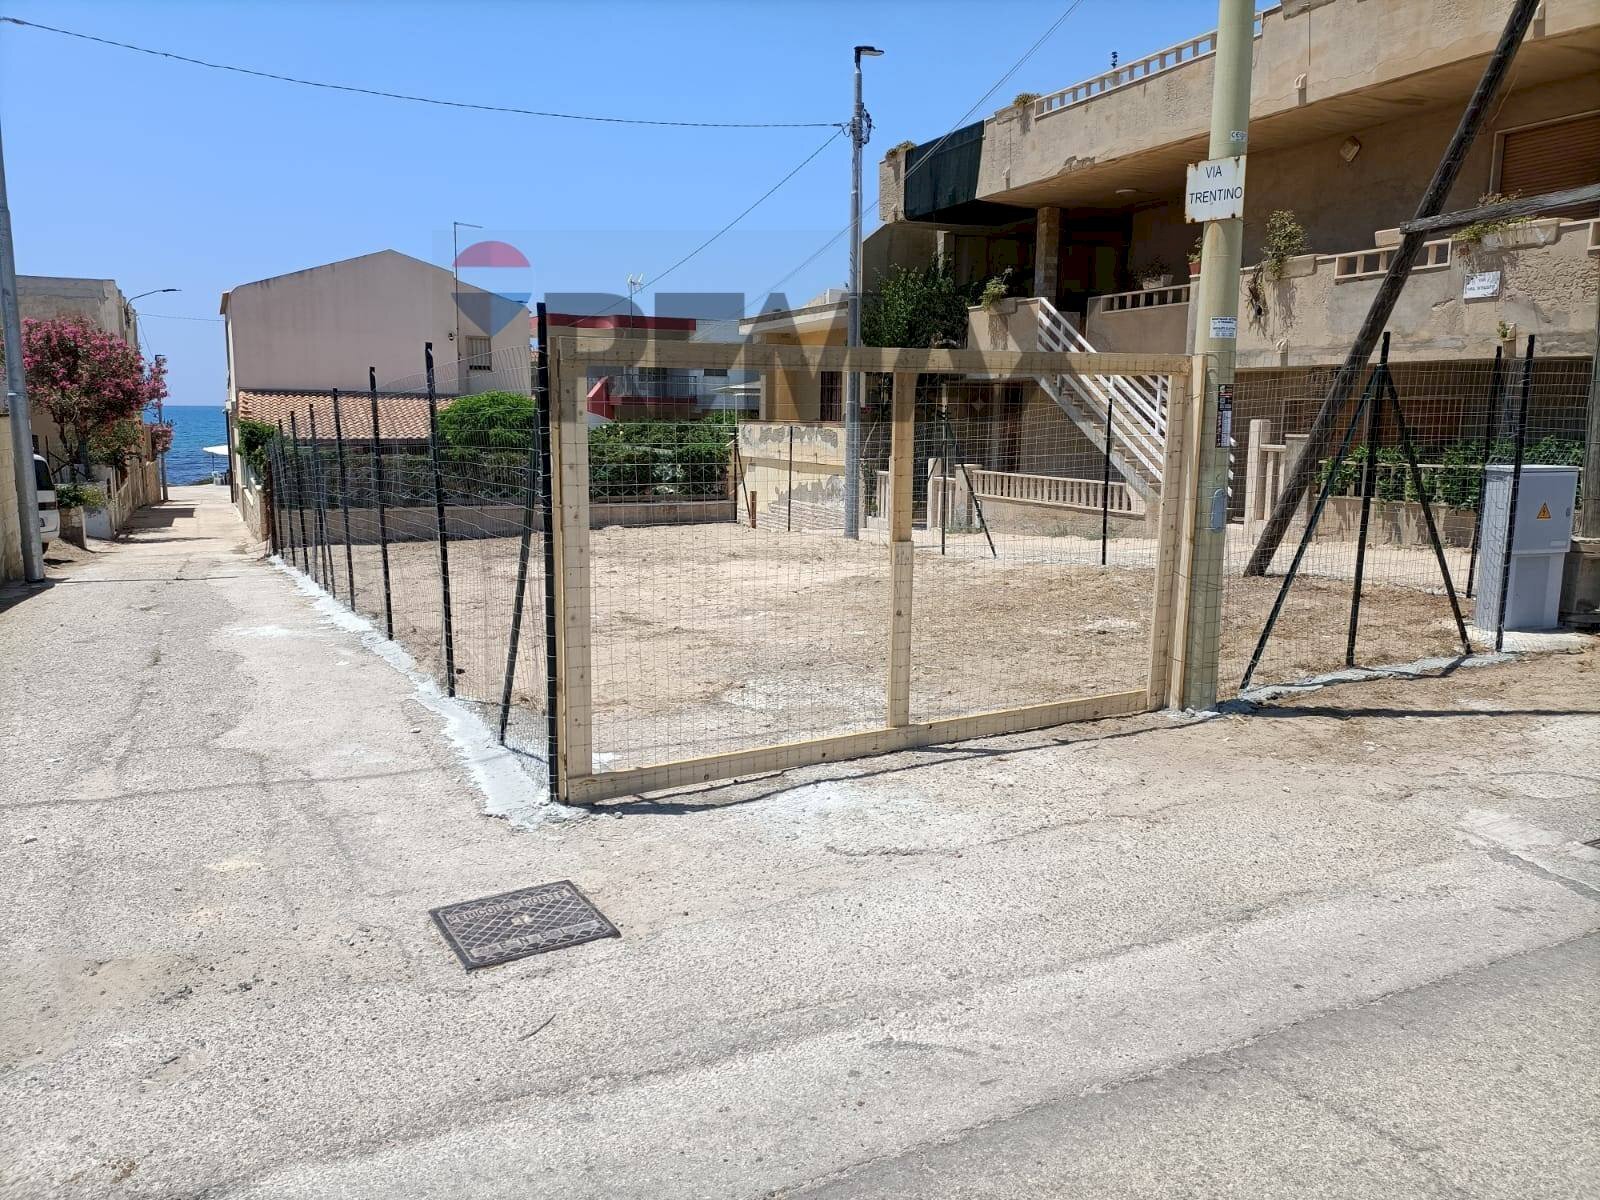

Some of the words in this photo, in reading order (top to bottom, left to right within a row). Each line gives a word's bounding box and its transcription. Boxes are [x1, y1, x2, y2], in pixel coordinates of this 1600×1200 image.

[1205, 165, 1223, 178] VIA
[1189, 186, 1243, 204] TRENTINO
[448, 904, 510, 924] PERICOLO
[521, 890, 568, 908] MORTE
[500, 927, 567, 949] ENEL
